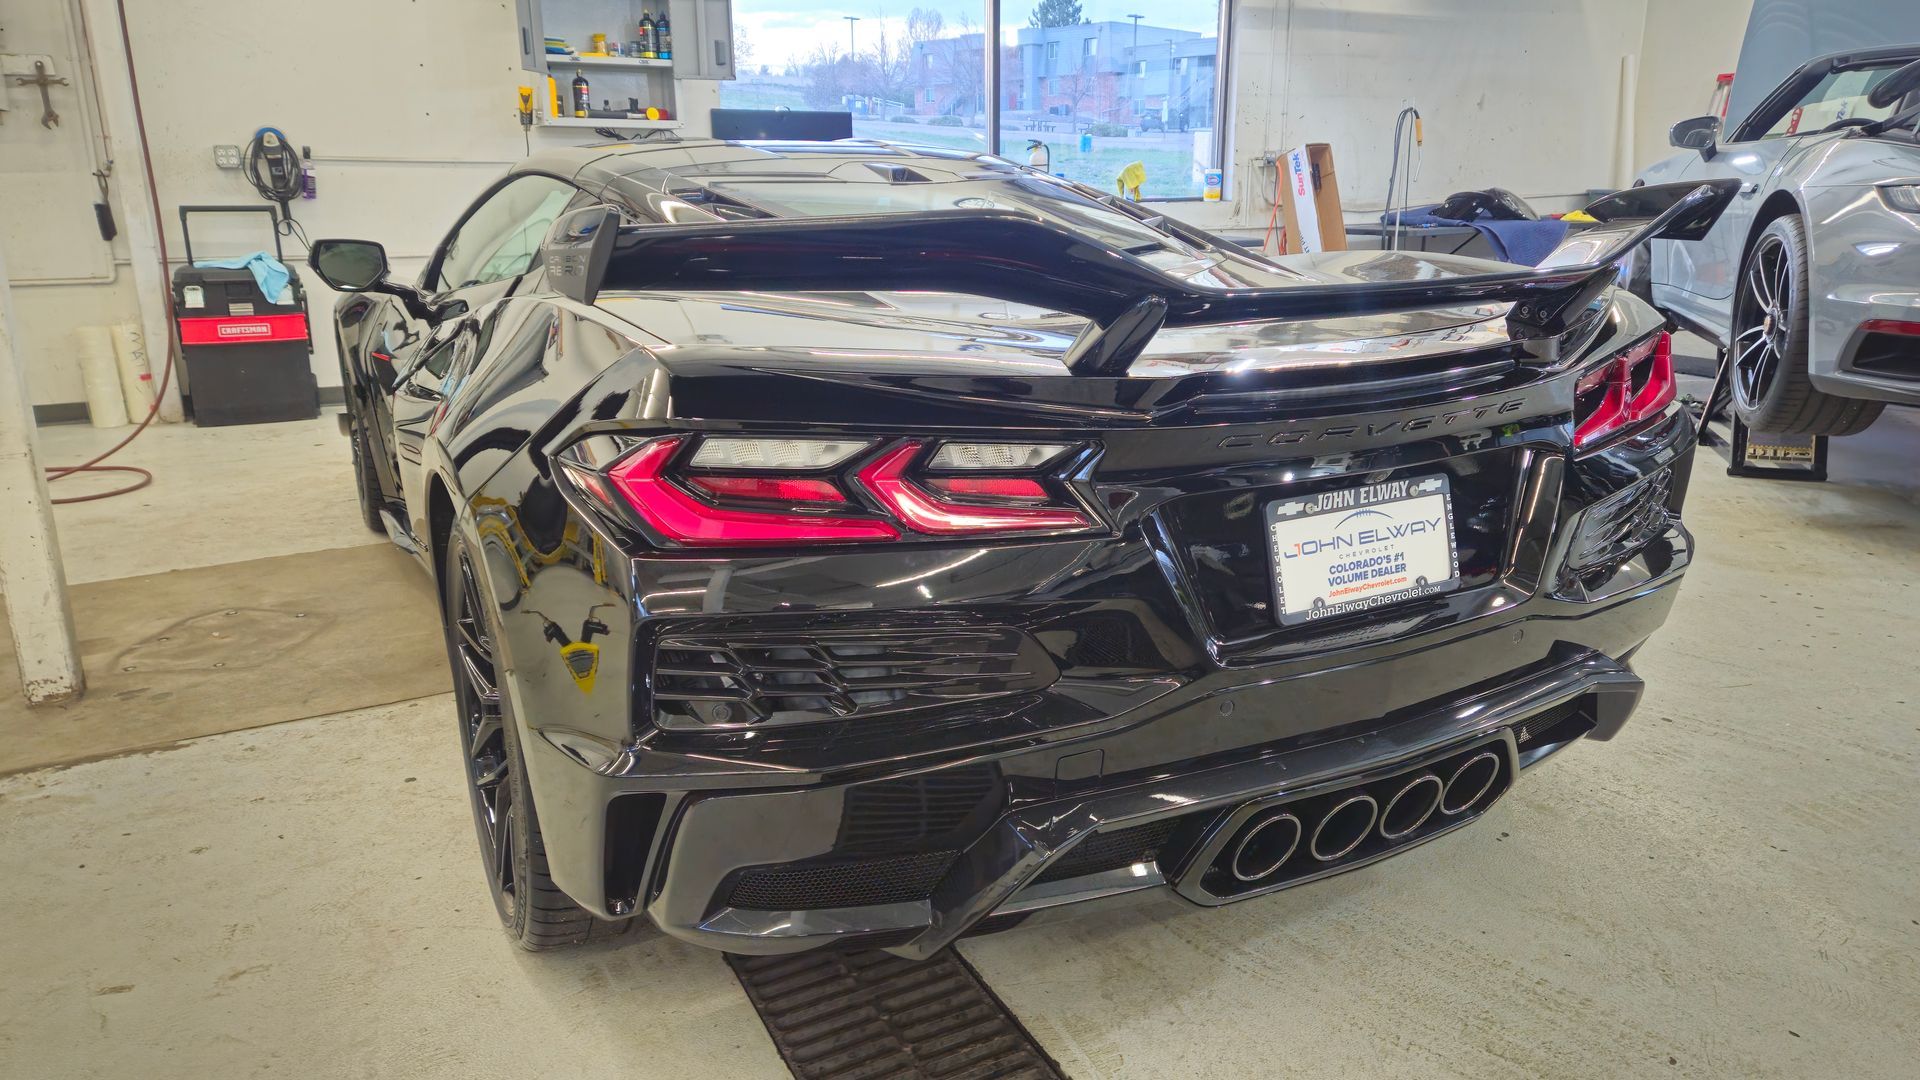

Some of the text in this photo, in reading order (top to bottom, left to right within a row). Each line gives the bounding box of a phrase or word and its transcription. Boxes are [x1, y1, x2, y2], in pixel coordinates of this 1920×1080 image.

[1292, 153, 1306, 197] SunTek
[221, 325, 268, 335] CRAFTSMAN
[1217, 398, 1527, 449] CORVETTE
[1314, 480, 1409, 512] JOHN ELWAY
[1284, 517, 1441, 559] JOHN ELWAY
[1339, 544, 1395, 559] CHEVROLET
[1446, 493, 1460, 578] ENGLEWOOD
[1270, 524, 1287, 614] CHEVROLET
[1393, 551, 1405, 563] #1
[1328, 563, 1407, 587] VOLUME DEALER
[1328, 576, 1408, 598] JohnElwayChevrolet.com
